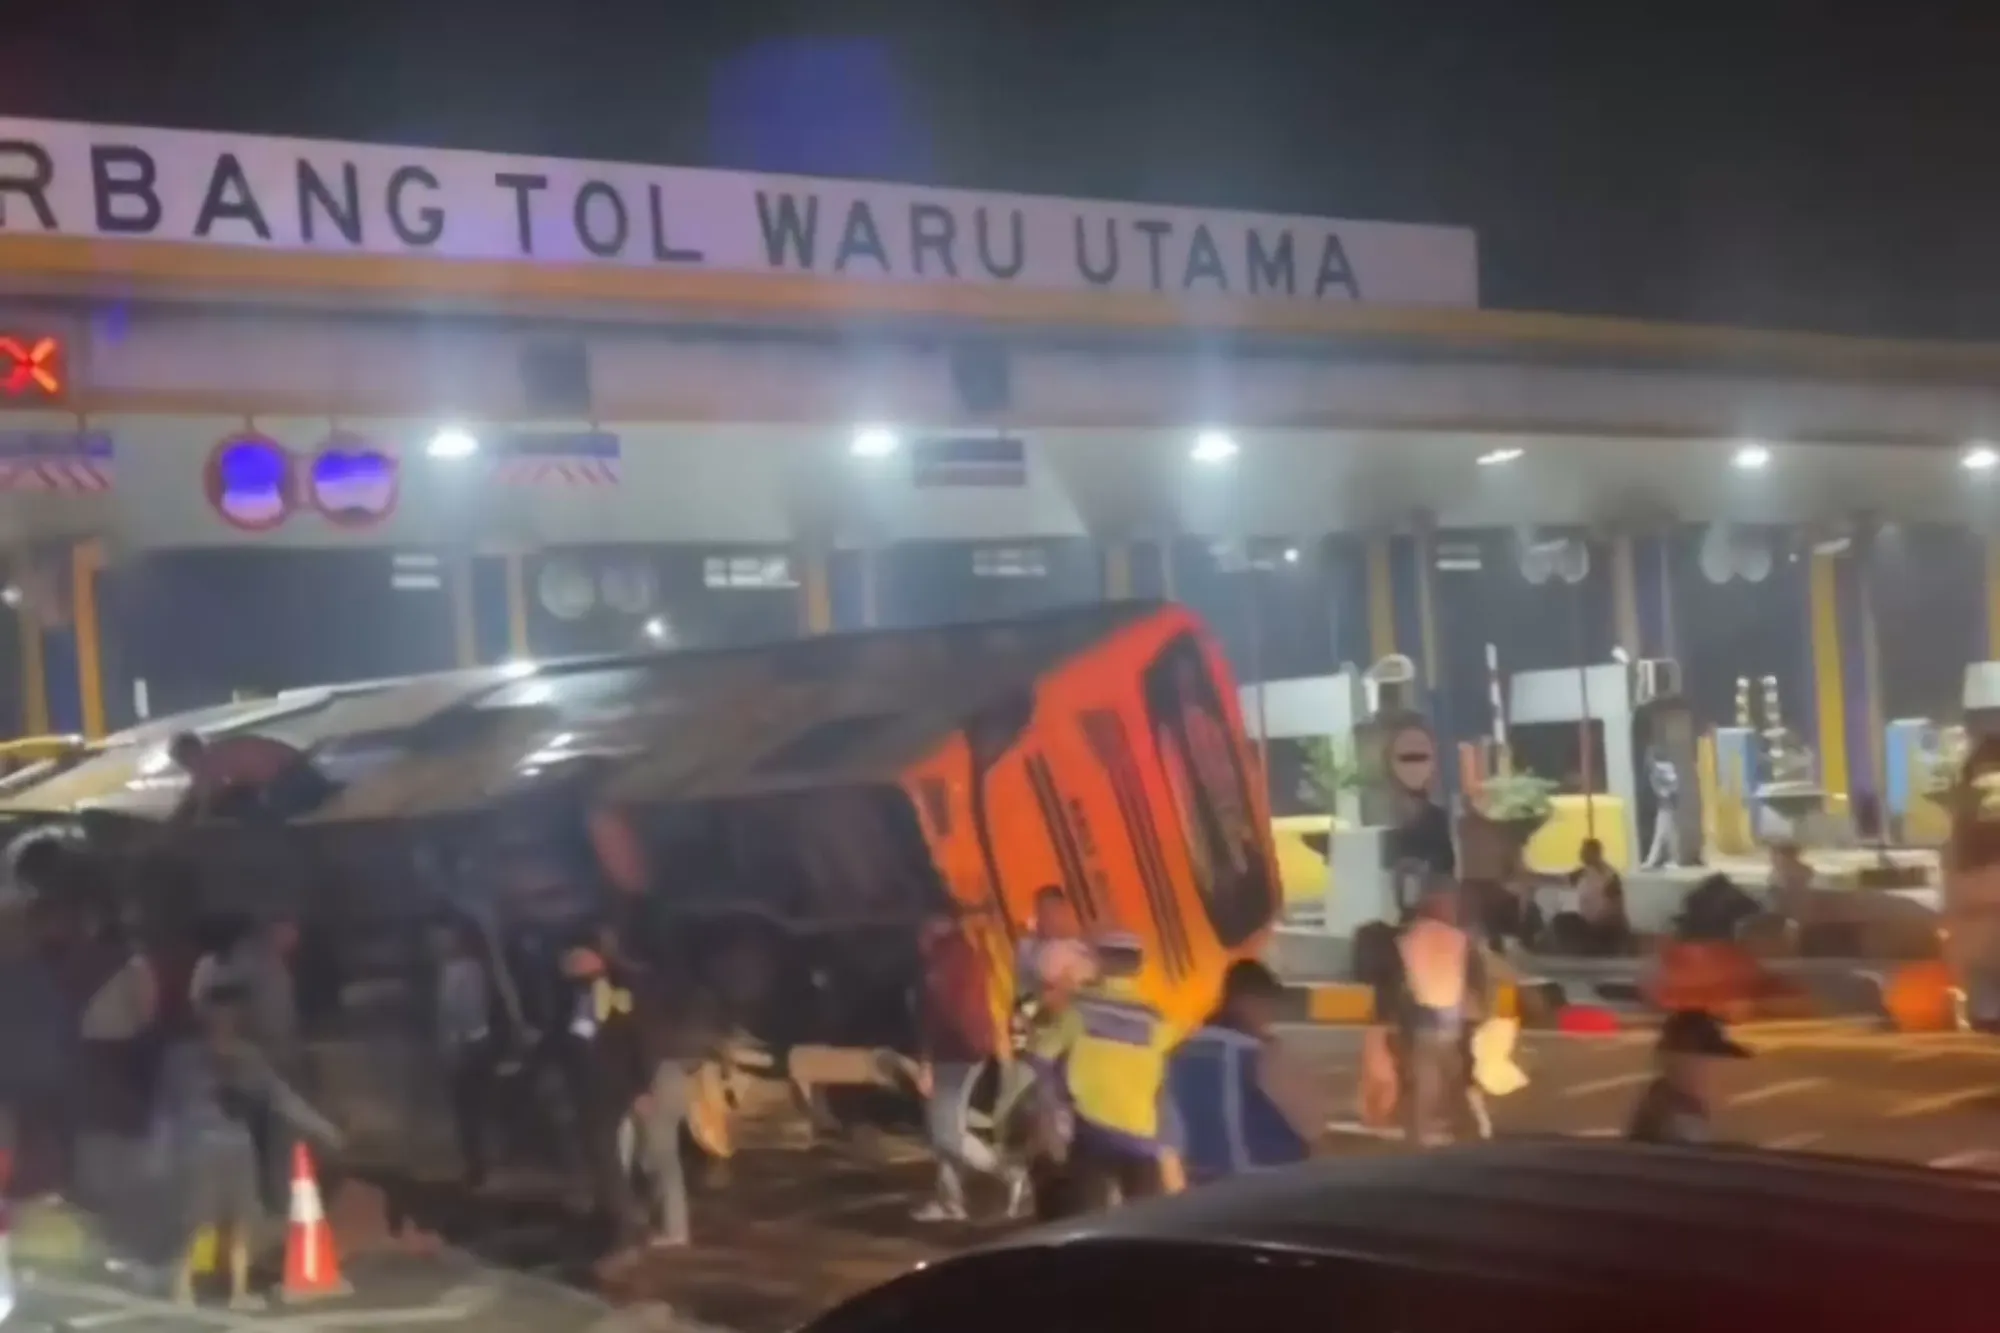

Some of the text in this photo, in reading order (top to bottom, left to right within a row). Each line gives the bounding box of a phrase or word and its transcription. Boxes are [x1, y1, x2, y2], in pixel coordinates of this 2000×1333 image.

[0, 140, 1361, 299] RBANG TOL WARU UTAMA
